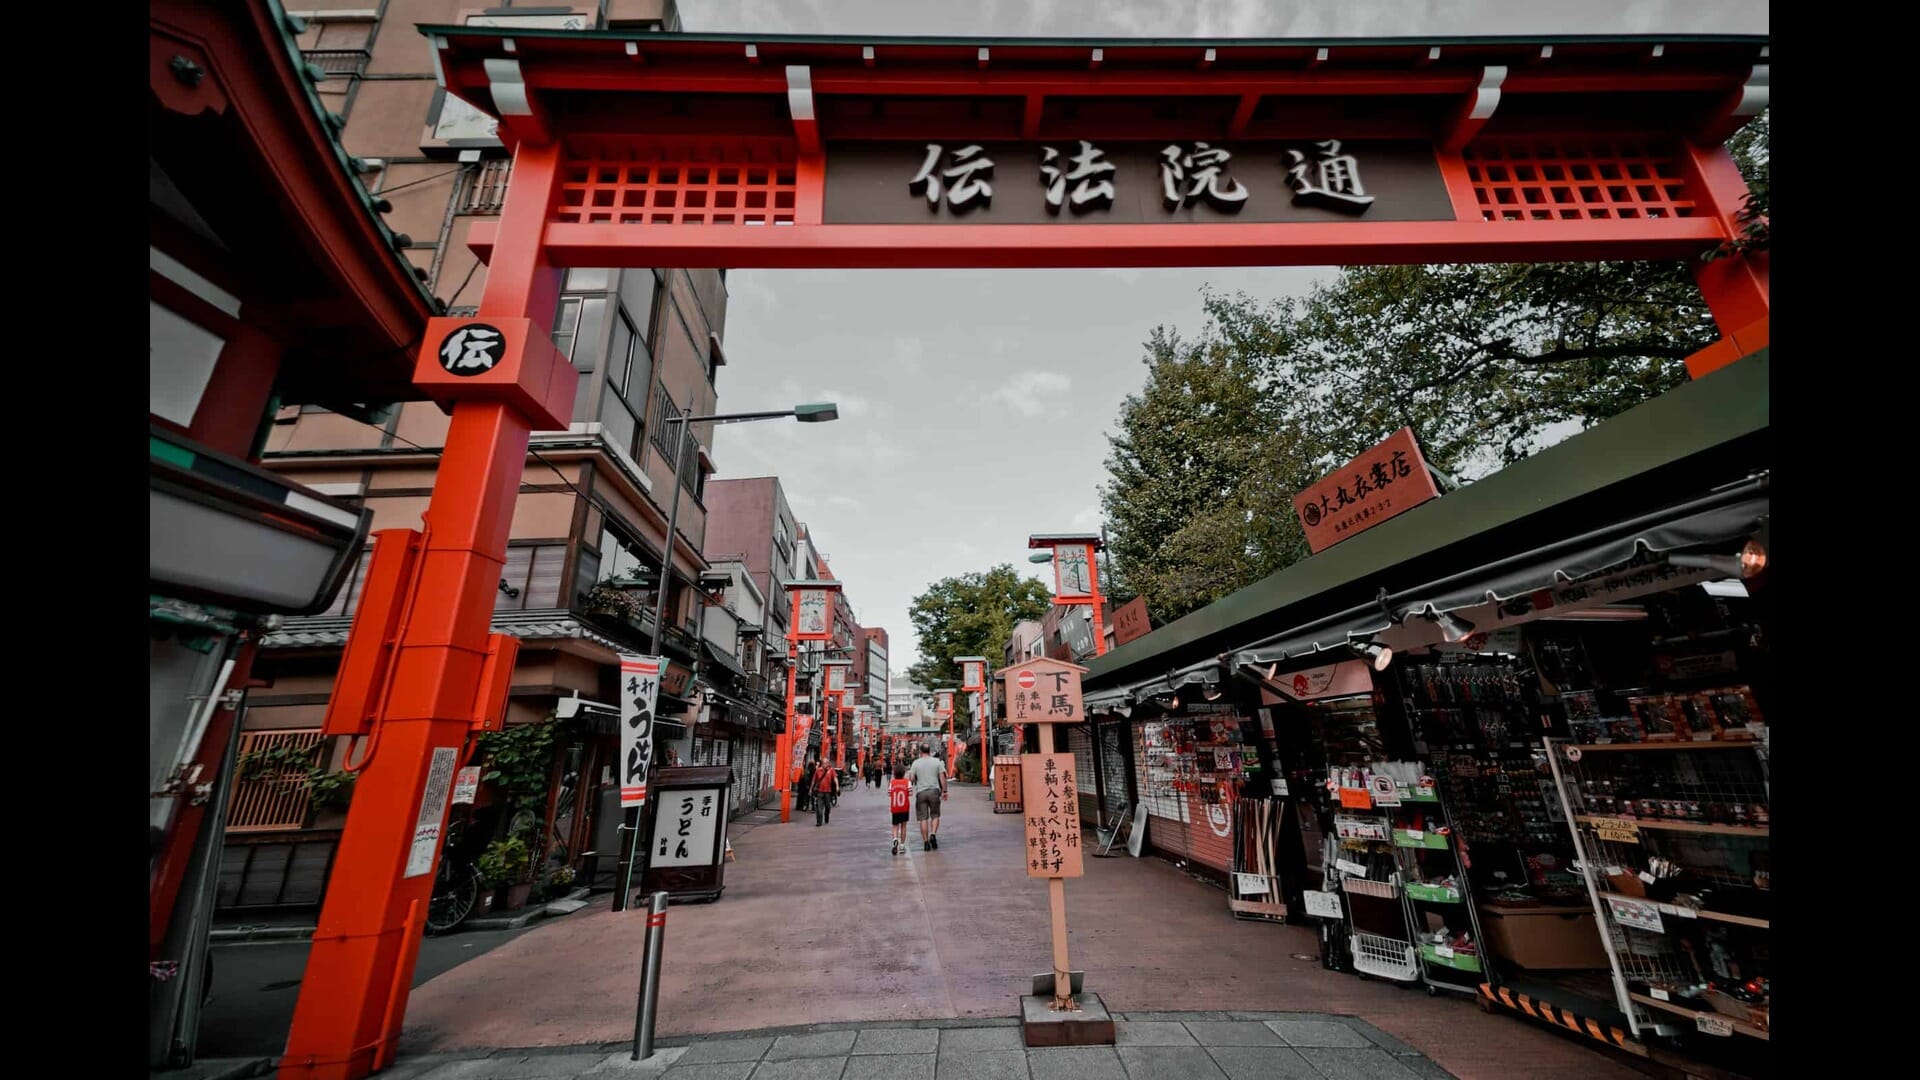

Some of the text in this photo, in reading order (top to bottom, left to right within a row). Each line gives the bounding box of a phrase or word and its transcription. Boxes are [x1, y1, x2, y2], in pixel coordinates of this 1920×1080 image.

[909, 139, 1376, 212] 伝法院通
[440, 328, 500, 370] 伝
[626, 676, 655, 698] 手打
[1015, 691, 1028, 719] 通行止
[1045, 671, 1075, 718] 下馬
[626, 696, 652, 785] うどん
[700, 795, 713, 818] 手打
[892, 790, 906, 807] 10
[1061, 769, 1079, 848] 表参道に付
[674, 796, 695, 859] うどん
